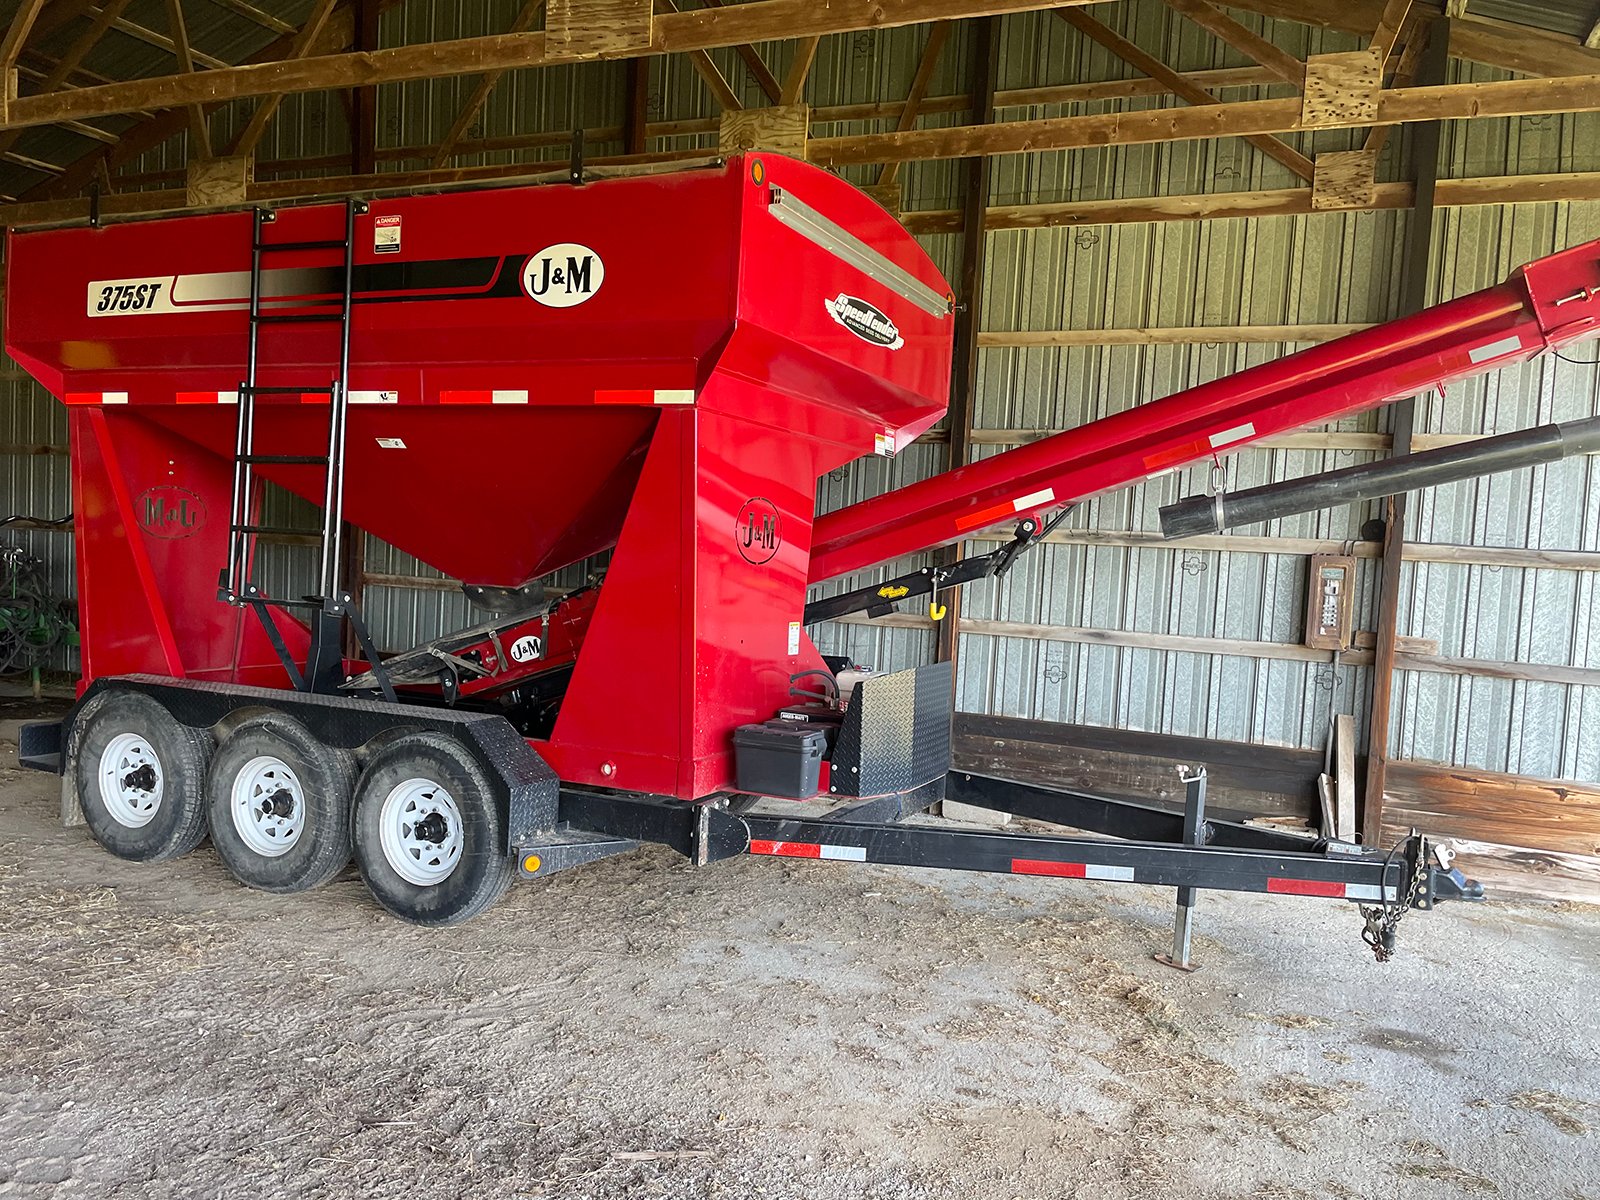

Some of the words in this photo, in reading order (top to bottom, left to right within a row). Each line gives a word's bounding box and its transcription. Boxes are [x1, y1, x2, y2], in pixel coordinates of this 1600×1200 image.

[530, 255, 593, 295] J&M
[97, 283, 162, 312] 375ST
[835, 295, 897, 338] SpeedTender
[742, 512, 776, 549] J&M
[513, 638, 541, 660] J&M
